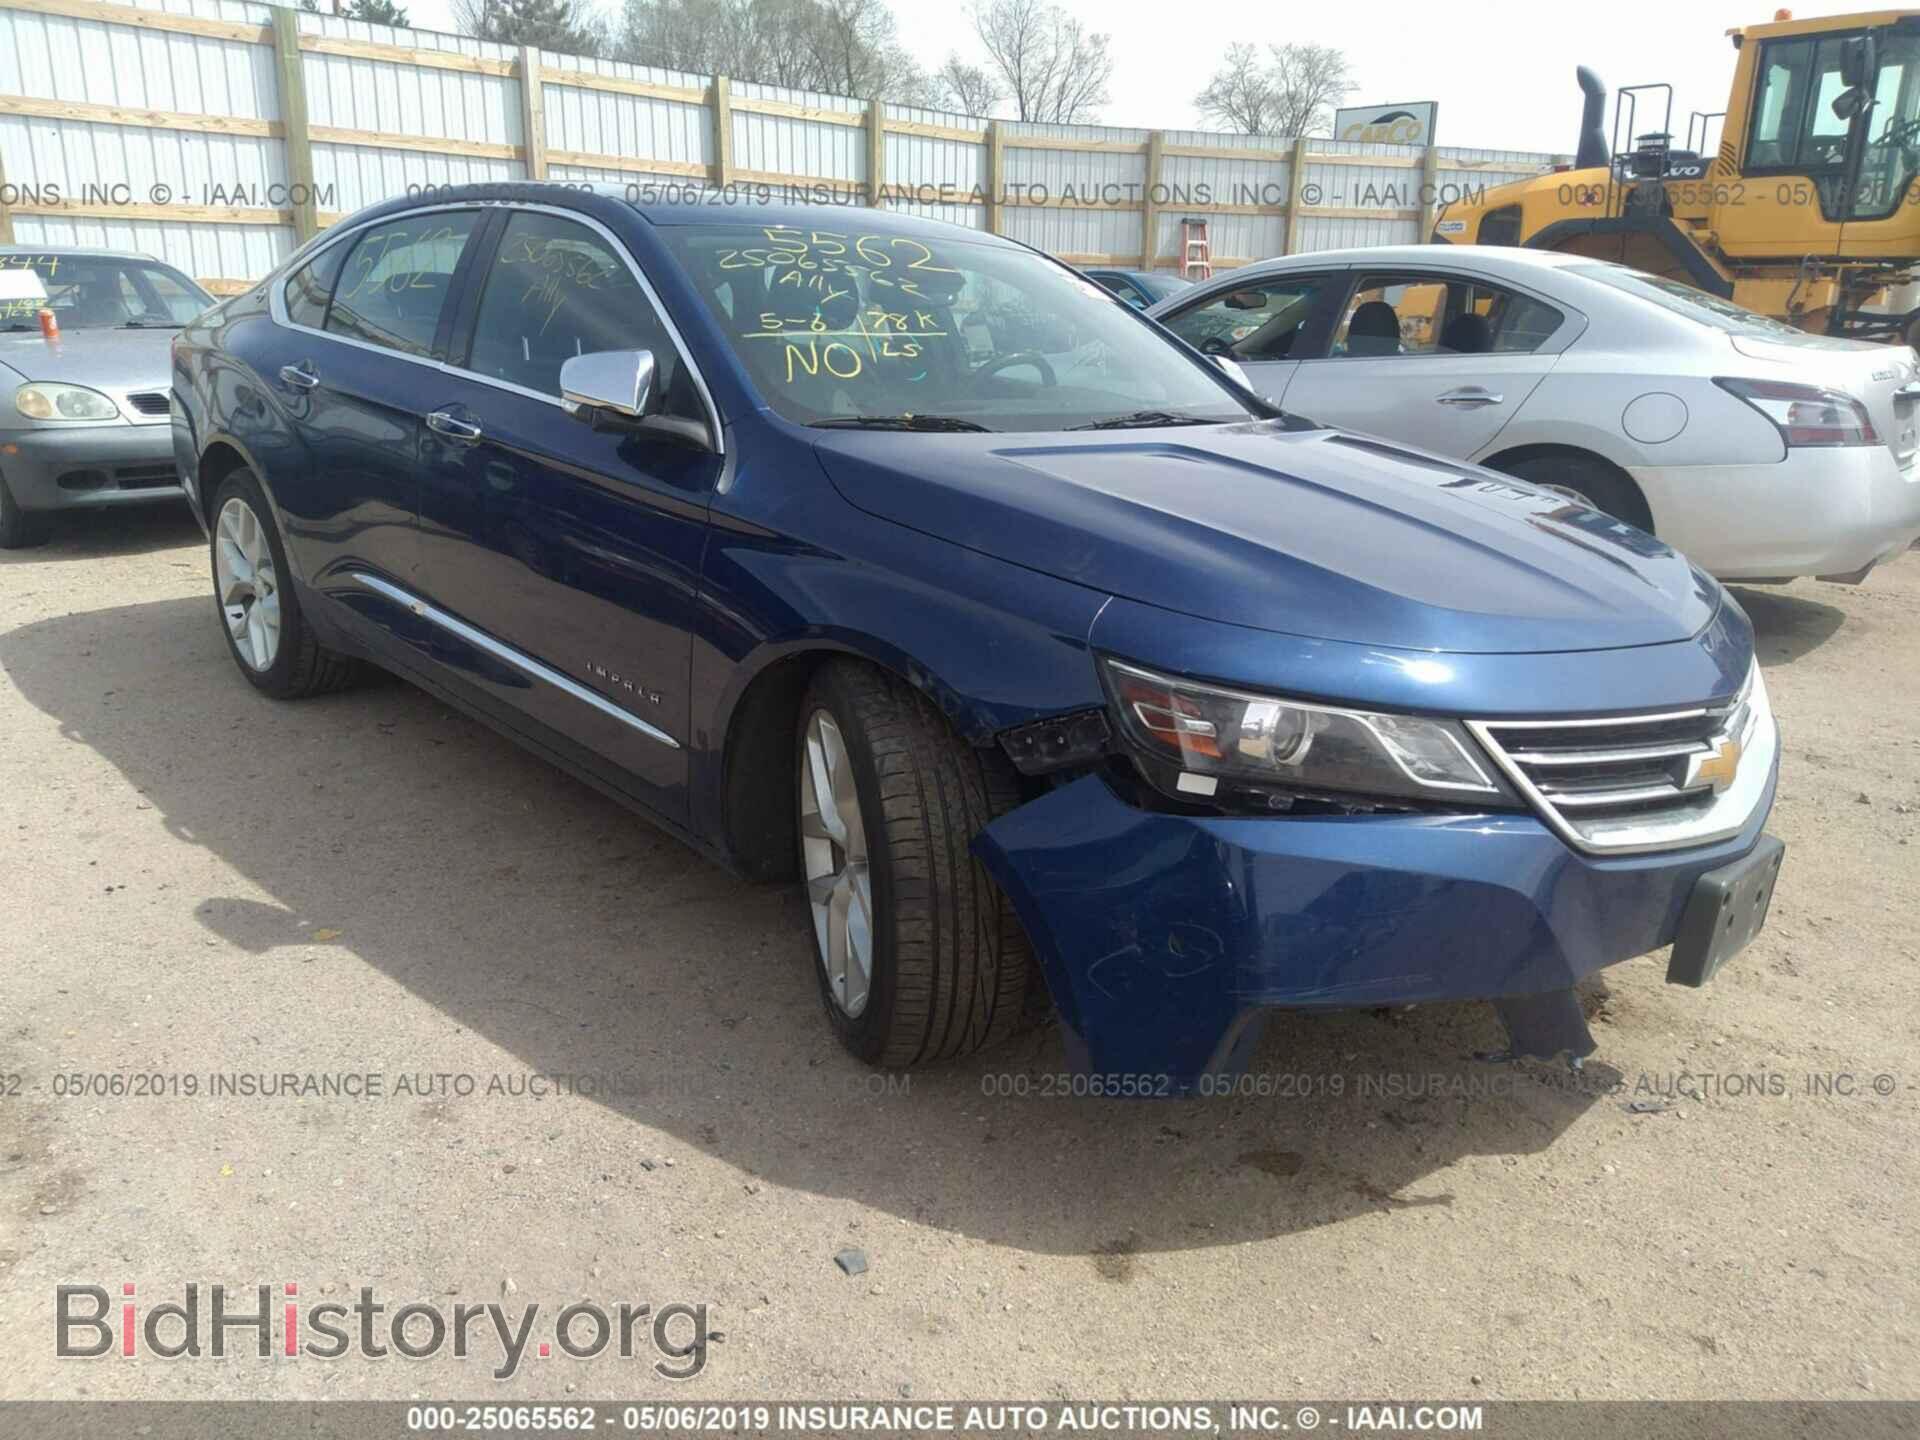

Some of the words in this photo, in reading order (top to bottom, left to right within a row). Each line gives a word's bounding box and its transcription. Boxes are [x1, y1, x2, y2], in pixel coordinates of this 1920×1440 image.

[763, 228, 962, 273] 5562
[717, 249, 931, 300] 25065562
[785, 340, 862, 383] NO
